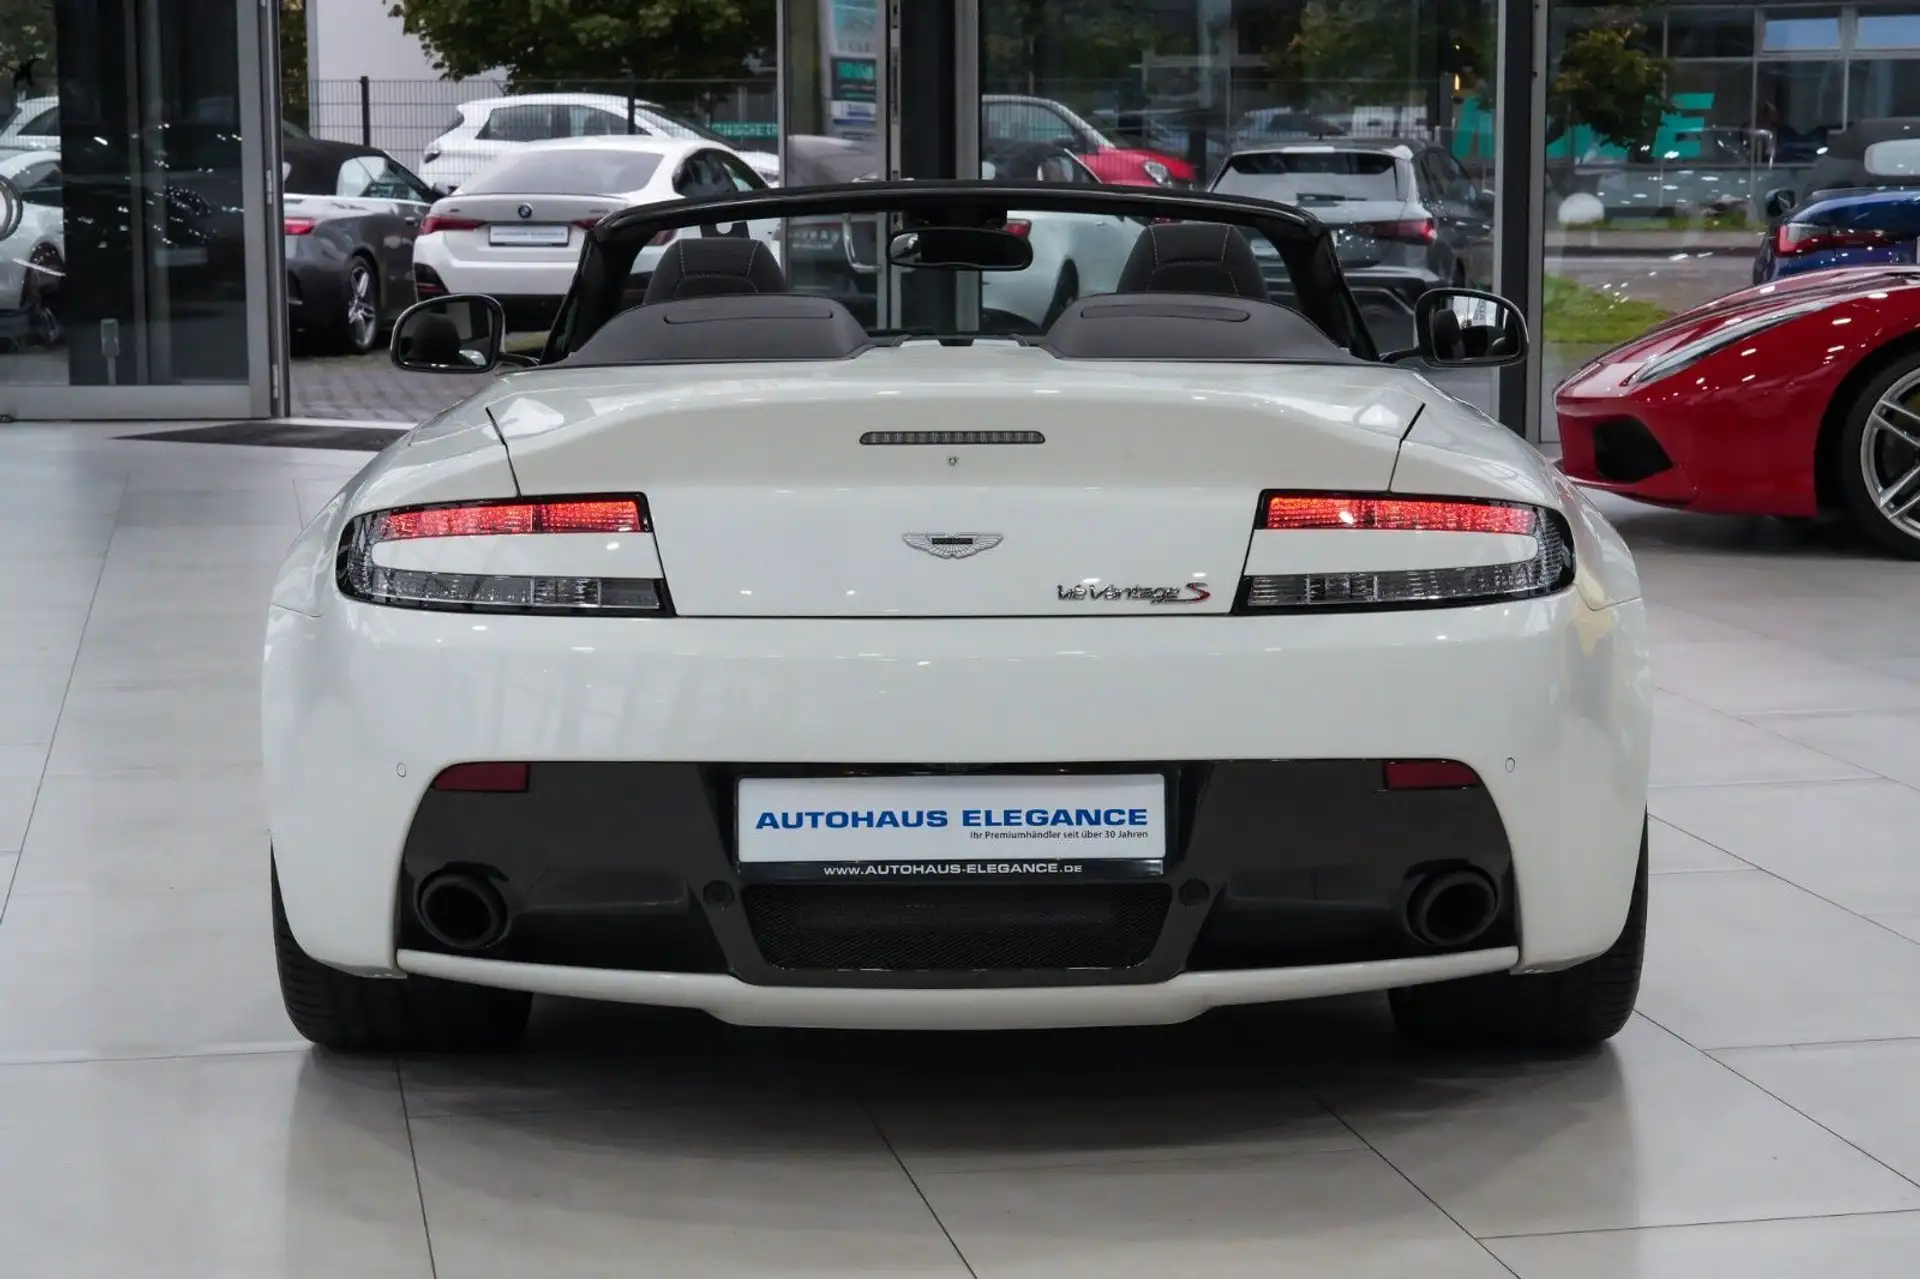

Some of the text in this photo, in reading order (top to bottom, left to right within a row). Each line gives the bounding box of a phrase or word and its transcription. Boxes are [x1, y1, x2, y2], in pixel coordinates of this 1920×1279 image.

[1089, 584, 1181, 605] Vantage
[1180, 581, 1211, 604] S
[755, 808, 1148, 829] AUTOHAUS ELEGANCE
[970, 830, 1149, 840] Ihr Premiumhändler seit über 30 Jahren
